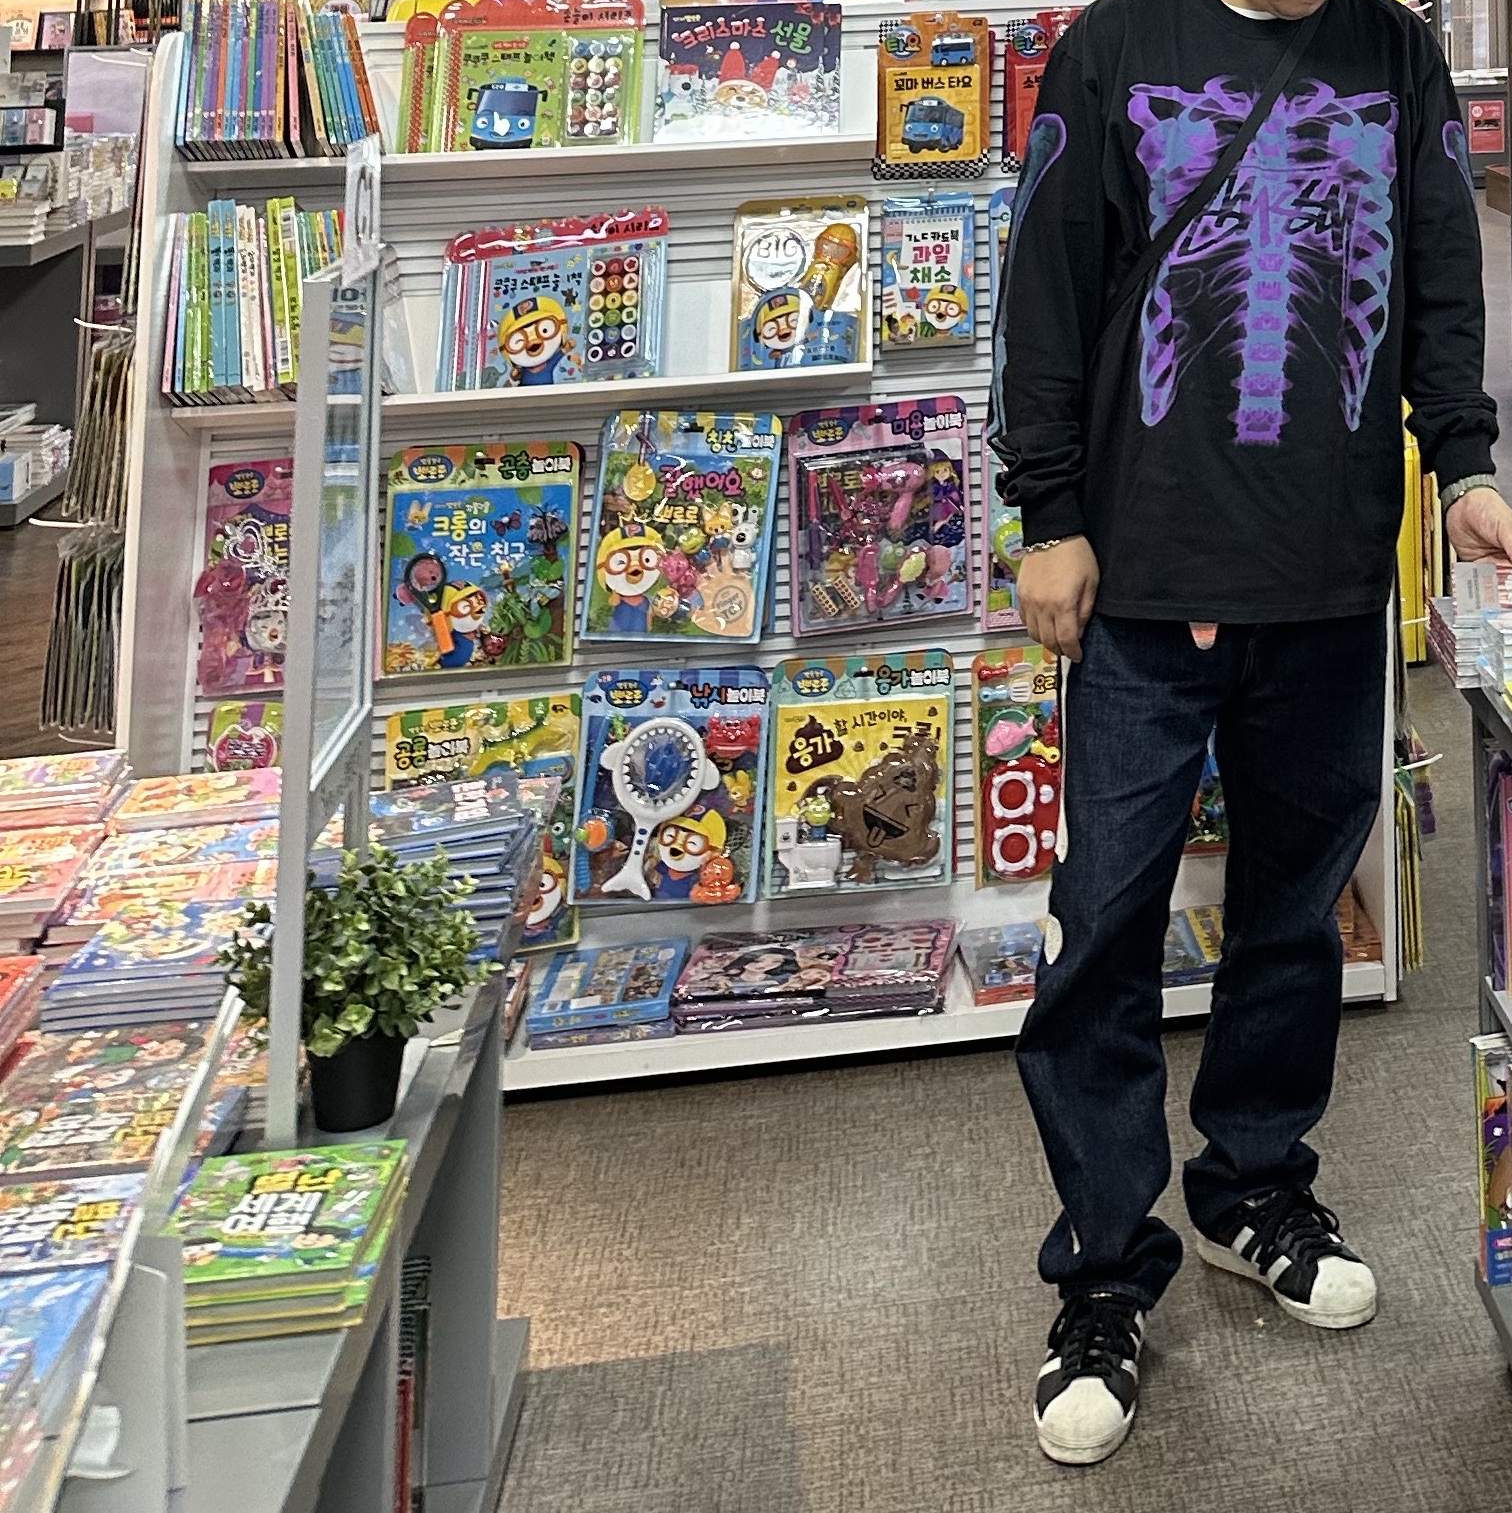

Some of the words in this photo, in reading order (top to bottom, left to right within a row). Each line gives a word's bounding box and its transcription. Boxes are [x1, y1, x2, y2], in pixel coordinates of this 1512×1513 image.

[671, 16, 768, 49] 크리스마스
[770, 19, 813, 54] 선물
[884, 31, 923, 54] 타요
[921, 76, 946, 90] 버스
[947, 74, 973, 89] 타요
[912, 244, 951, 264] 과일
[909, 265, 952, 284] 채소
[432, 510, 487, 542] 크롱의
[447, 539, 485, 568] 작은
[490, 541, 527, 564] 친구
[792, 731, 835, 768] 응가
[834, 718, 848, 737] 할
[851, 708, 909, 730] 시간이야,
